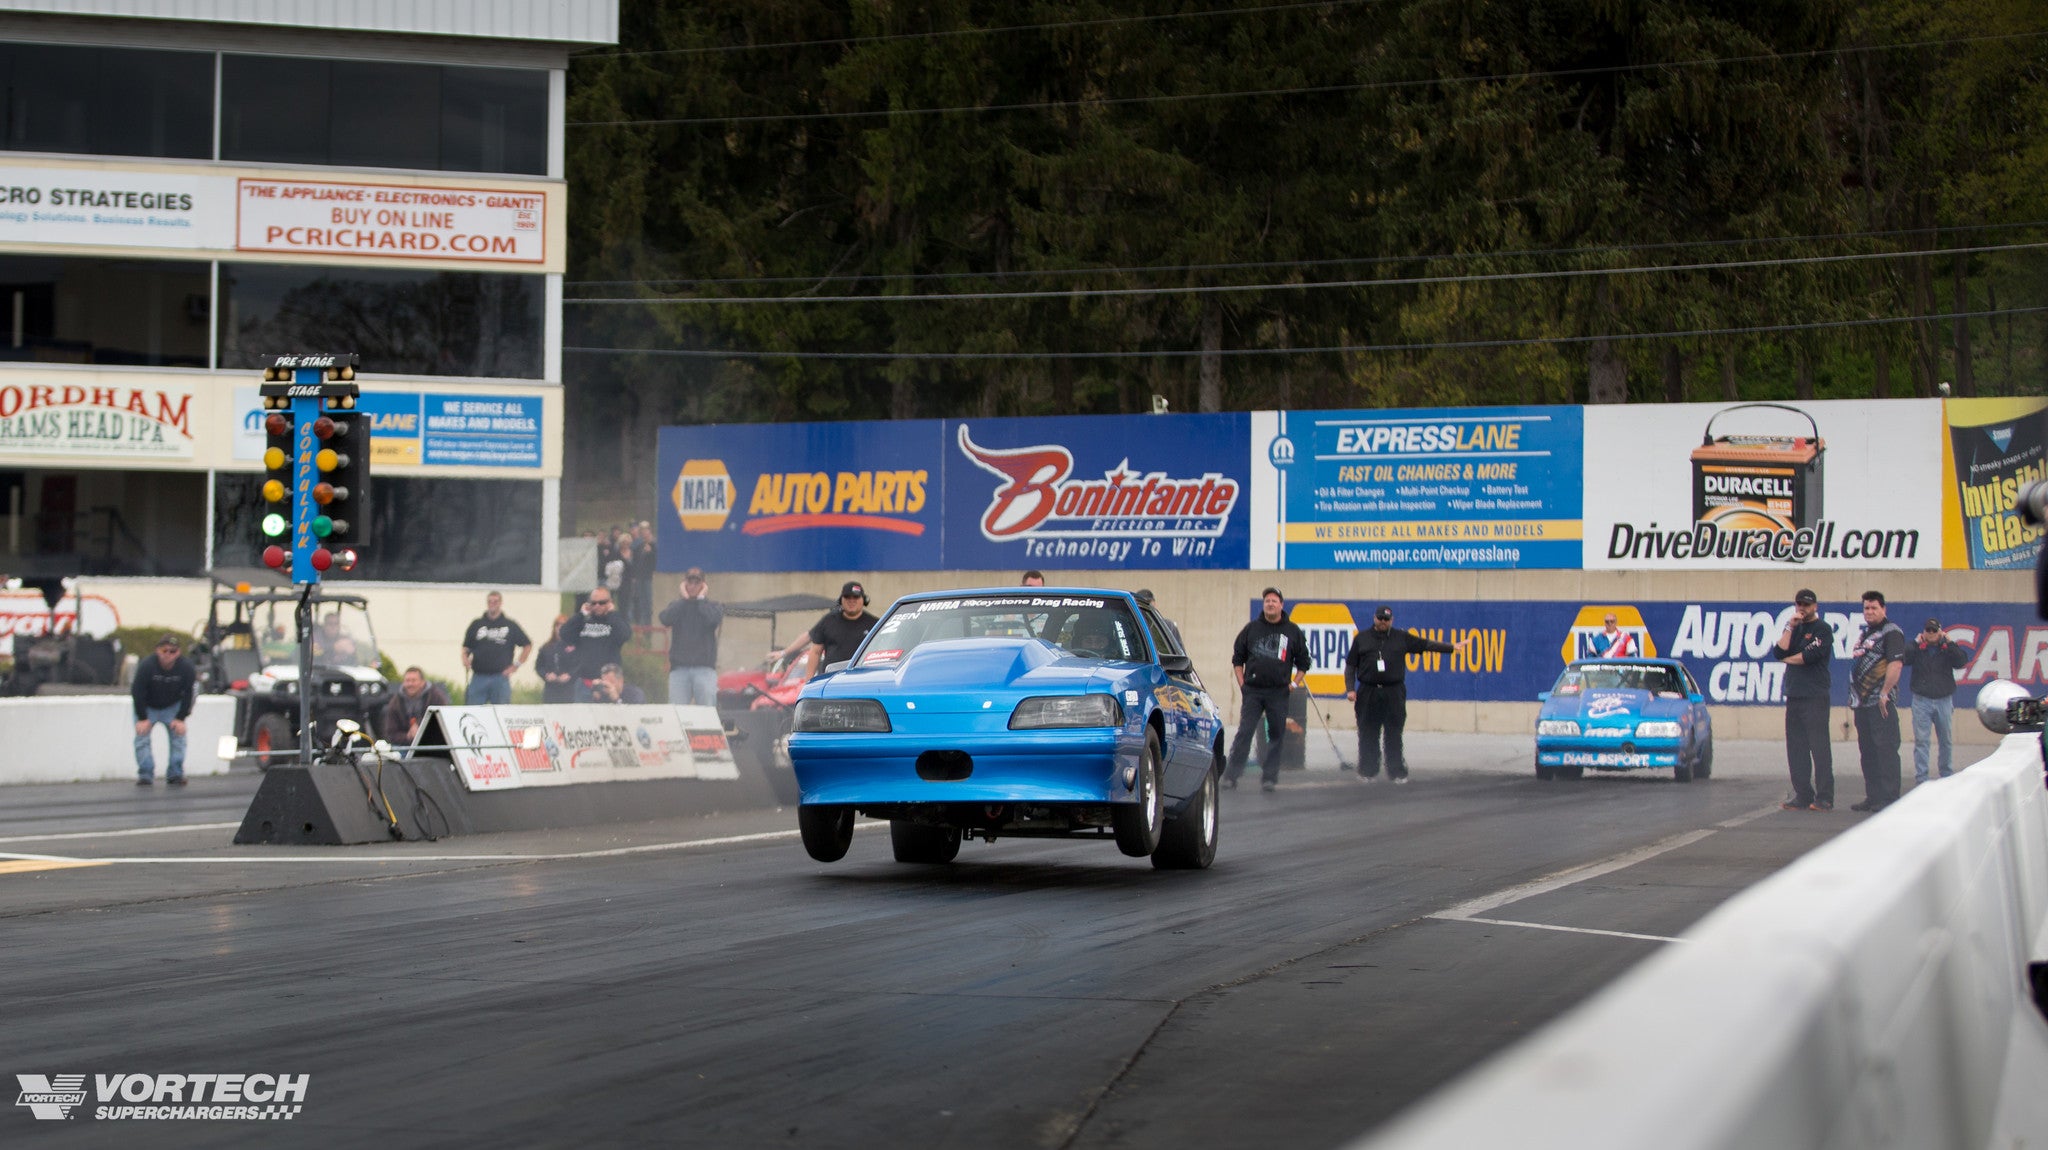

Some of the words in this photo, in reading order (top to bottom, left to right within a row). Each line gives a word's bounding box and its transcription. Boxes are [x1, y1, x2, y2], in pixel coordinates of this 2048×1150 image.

[51, 188, 193, 211] STRATEGIES
[281, 187, 364, 201] APPLIANCE
[375, 191, 475, 207] ELECTRONICS
[332, 207, 372, 224] BUY
[377, 209, 406, 226] ON
[412, 210, 454, 229] LINE
[266, 226, 517, 254] PCRICHARD.COM
[275, 356, 335, 367] PRE-STAGE
[287, 385, 322, 396] STAGE
[442, 401, 461, 414] WE
[462, 402, 503, 415] SERVICE
[505, 403, 524, 415] ALL
[0, 411, 62, 438] RAMS
[68, 410, 124, 440] HEAD
[130, 417, 165, 443] IPA
[428, 416, 466, 429] MAKES
[468, 417, 490, 430] AND
[1336, 424, 1522, 454] EXPRESSLANE
[958, 423, 1239, 542] Boninfante
[1338, 465, 1373, 483] FAST
[1374, 464, 1395, 482] OIL
[1396, 463, 1461, 482] CHANGES
[1463, 463, 1474, 480] &
[1476, 462, 1518, 480] MORE
[682, 478, 727, 511] NAPA
[748, 471, 831, 516] AUTO
[832, 469, 929, 514] PARTS
[1355, 486, 1385, 499] Changes
[1400, 485, 1439, 497] Multi-Point
[1440, 485, 1470, 497] Checkup
[1487, 484, 1512, 497] Battery
[1513, 484, 1529, 496] Test
[1704, 475, 1793, 497] DURACELL
[1961, 457, 2048, 518] Invisibl
[1333, 501, 1361, 512] Rotation
[1362, 501, 1378, 512] with
[1378, 500, 1399, 511] Brake
[1399, 499, 1436, 512] Inspection
[1452, 499, 1474, 512] Wiper
[1475, 498, 1496, 510] Blade
[1496, 498, 1543, 511] Replacement
[1091, 518, 1165, 531] Friction
[1315, 525, 1333, 538] WE
[1338, 525, 1387, 538] SERVICE
[1391, 524, 1412, 537] ALL
[1416, 524, 1459, 537] MAKES
[1463, 524, 1489, 537] AND
[1493, 523, 1544, 537] MODELS
[1980, 504, 2047, 554] Glas
[1025, 538, 1132, 562] Technology
[1141, 538, 1161, 557] To
[1172, 538, 1216, 557] Win!
[1608, 519, 1919, 560] DriveDuracell.com
[1333, 545, 1520, 565] www.mopar.com/expresslane
[917, 600, 960, 612] NMRA
[1031, 597, 1061, 608] Drag
[1062, 597, 1104, 609] Racing
[880, 620, 902, 635] 2
[1301, 629, 1350, 669] APA
[1449, 627, 1507, 673] HOW
[1708, 661, 1788, 703] CENT
